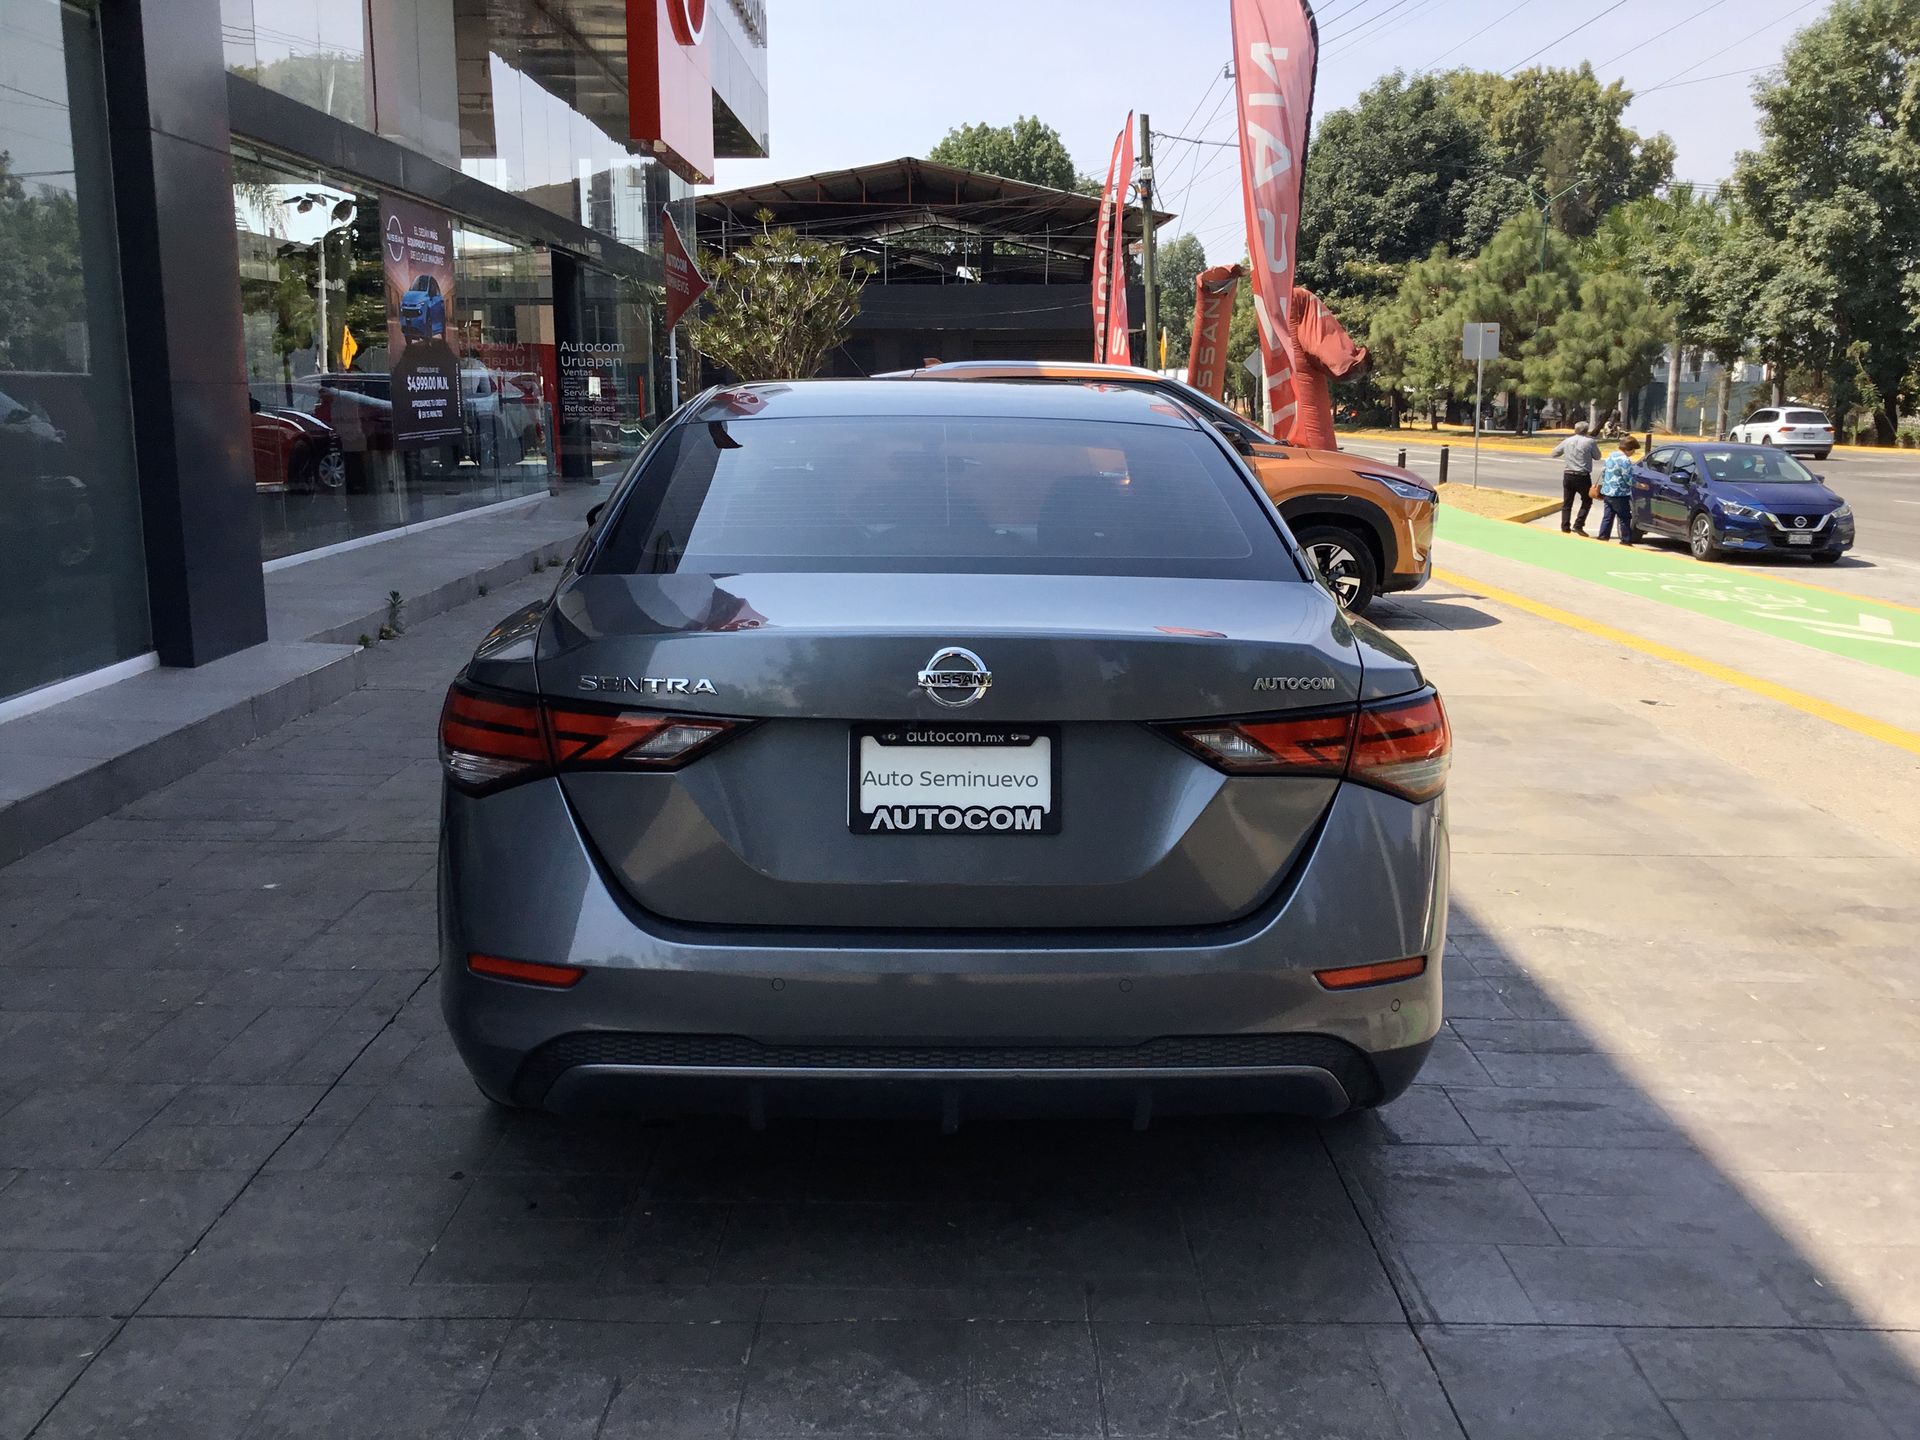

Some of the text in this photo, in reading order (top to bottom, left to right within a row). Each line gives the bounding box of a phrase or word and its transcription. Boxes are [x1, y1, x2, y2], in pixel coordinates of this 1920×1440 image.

[386, 232, 405, 244] NISSAN
[560, 341, 625, 353] Autocom
[561, 355, 622, 370] Uruapan
[407, 375, 436, 392] $4,999.00
[578, 676, 718, 695] SENTRA
[925, 674, 984, 684] NISSAN
[1253, 677, 1335, 690] AUTOCOM
[906, 730, 1005, 743] autocom.mx
[862, 770, 1039, 788] Auto Seminuevo
[869, 808, 1042, 830] AUTOCOM
